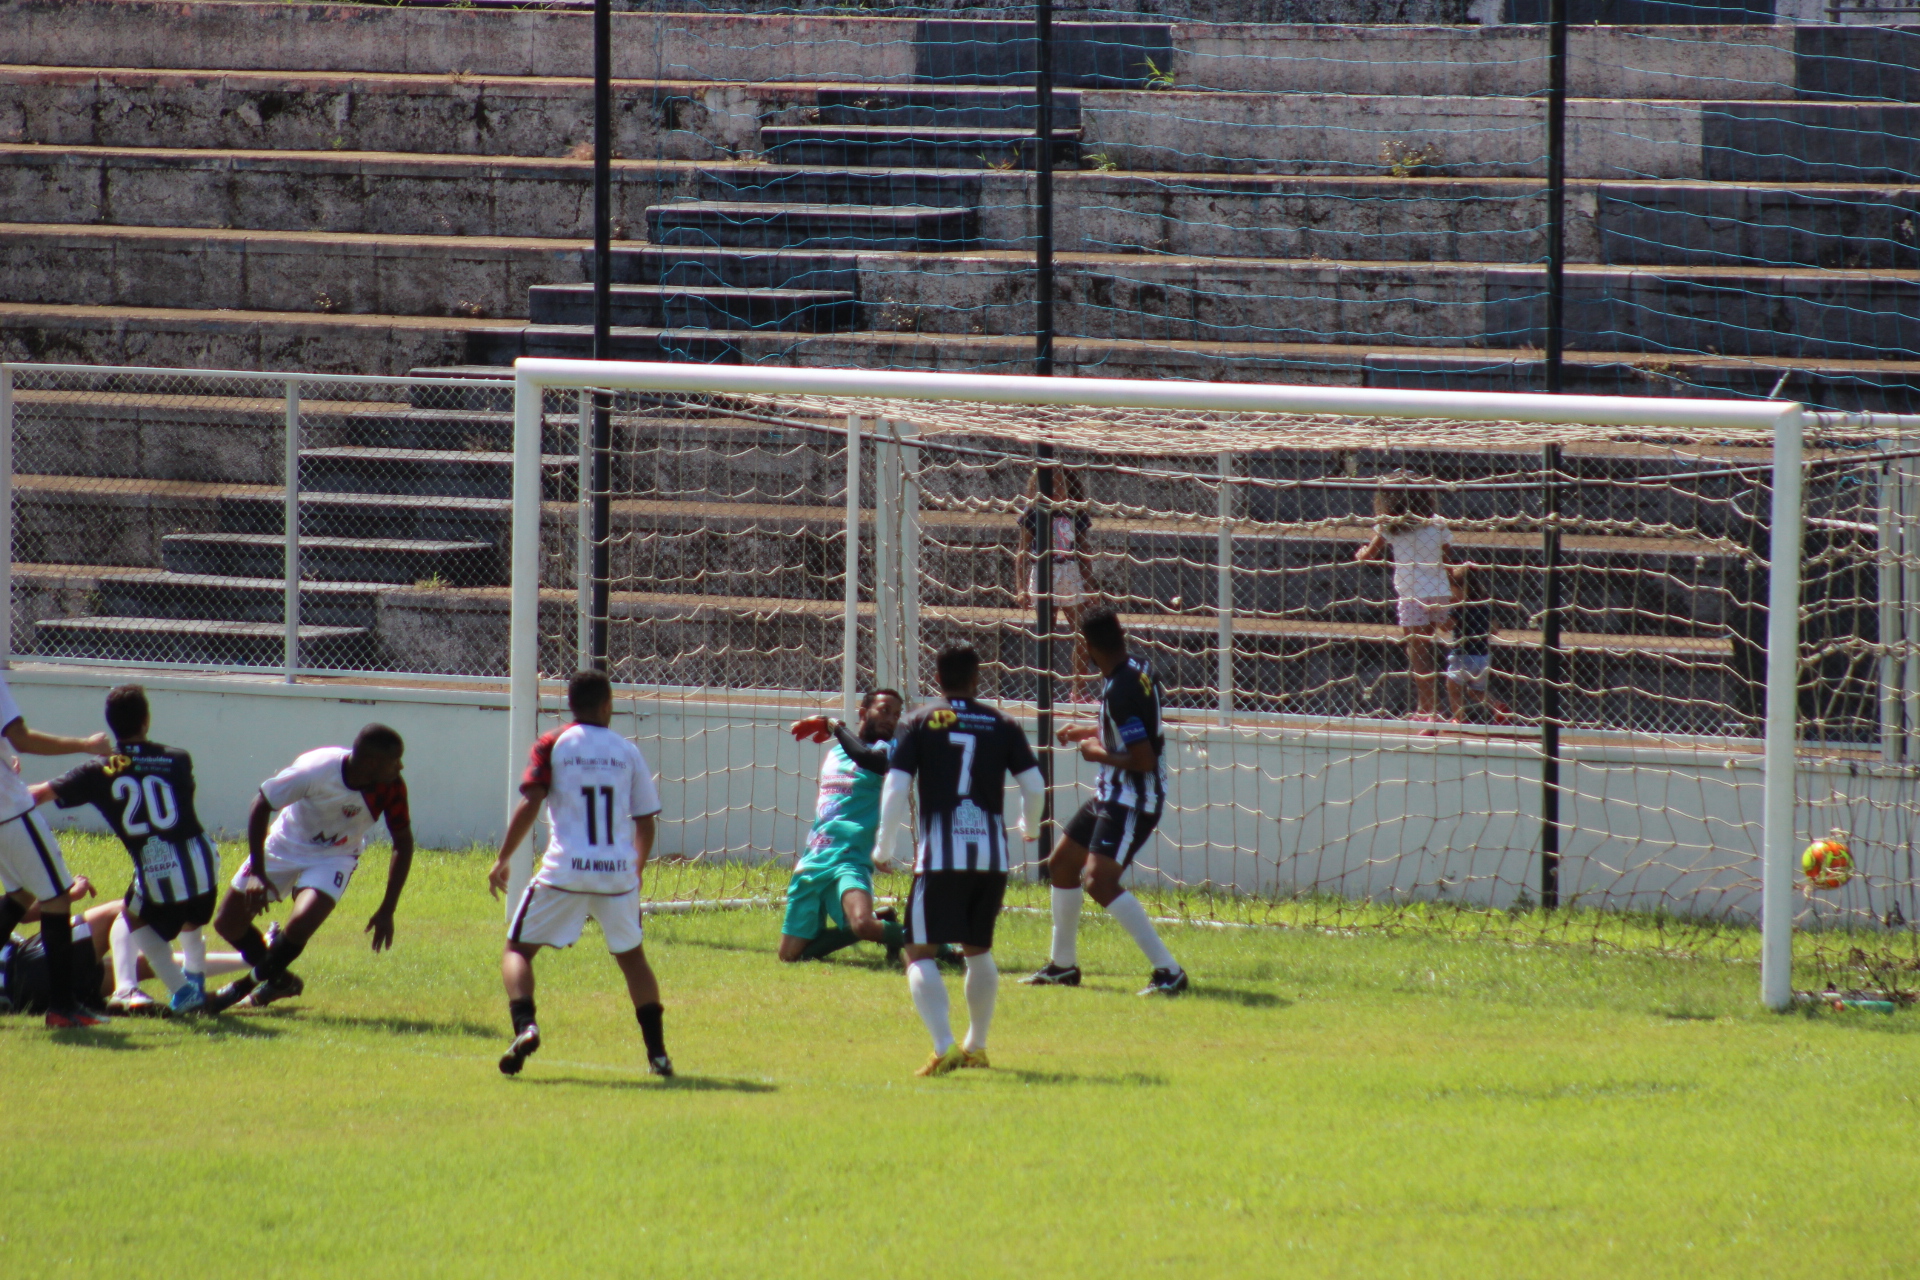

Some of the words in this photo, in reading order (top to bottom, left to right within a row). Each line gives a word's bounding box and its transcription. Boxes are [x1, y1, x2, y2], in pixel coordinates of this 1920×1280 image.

[928, 709, 957, 729] JP
[949, 731, 976, 796] 7
[111, 774, 179, 836] 20
[581, 785, 614, 846] 11
[953, 827, 988, 836] ASERPA
[143, 861, 178, 873] ASERPA
[571, 857, 591, 871] VILA
[593, 859, 615, 872] NOVA
[333, 870, 344, 888] 8
